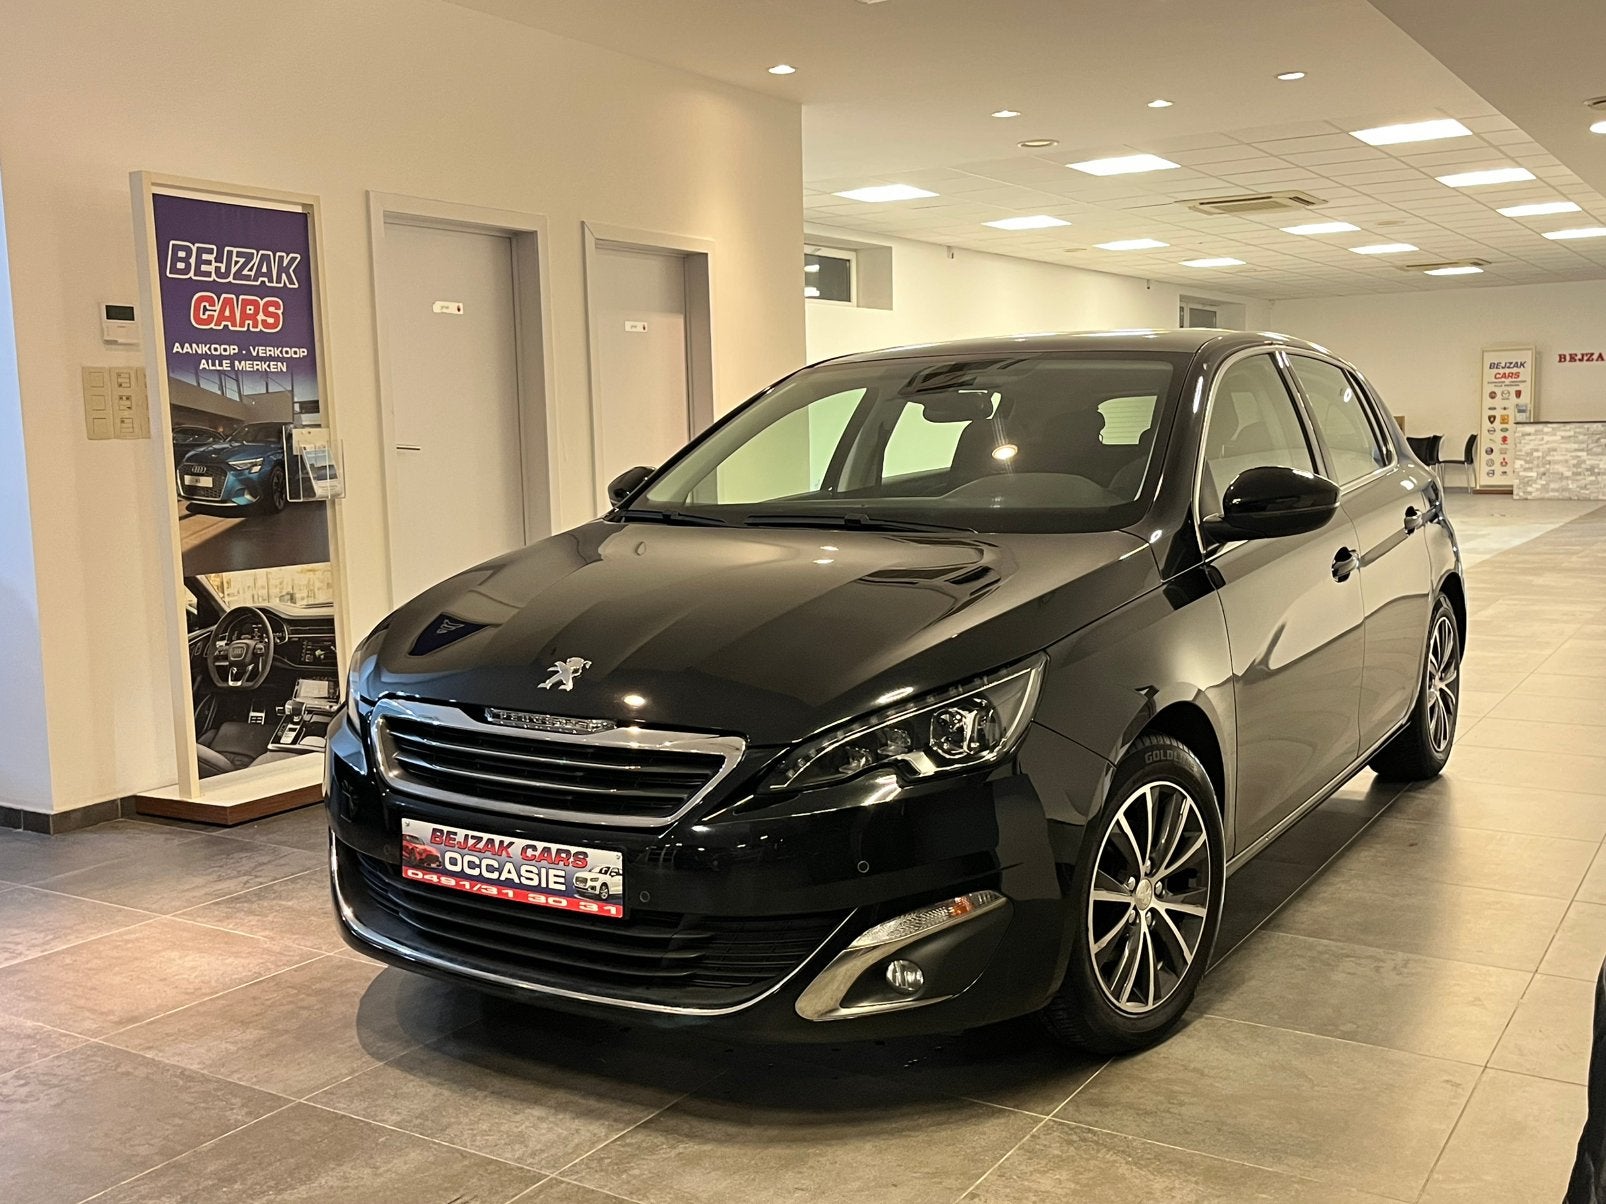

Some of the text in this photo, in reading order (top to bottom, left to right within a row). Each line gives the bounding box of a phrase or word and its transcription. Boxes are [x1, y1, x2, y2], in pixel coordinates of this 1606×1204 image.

[166, 240, 300, 288] BEJZAK
[190, 292, 283, 332] CARS
[172, 342, 239, 356] AANKOOP
[249, 346, 308, 358] VERKOOP
[1558, 352, 1605, 363] BEJZA
[199, 359, 287, 372] ALLE MERKEN
[1489, 361, 1527, 370] BEJZAK
[1494, 372, 1520, 380] CARS
[430, 828, 589, 869] BEJZAK CARS
[444, 851, 567, 891] OCCASIE
[407, 869, 618, 915] 0491/31 30 31
